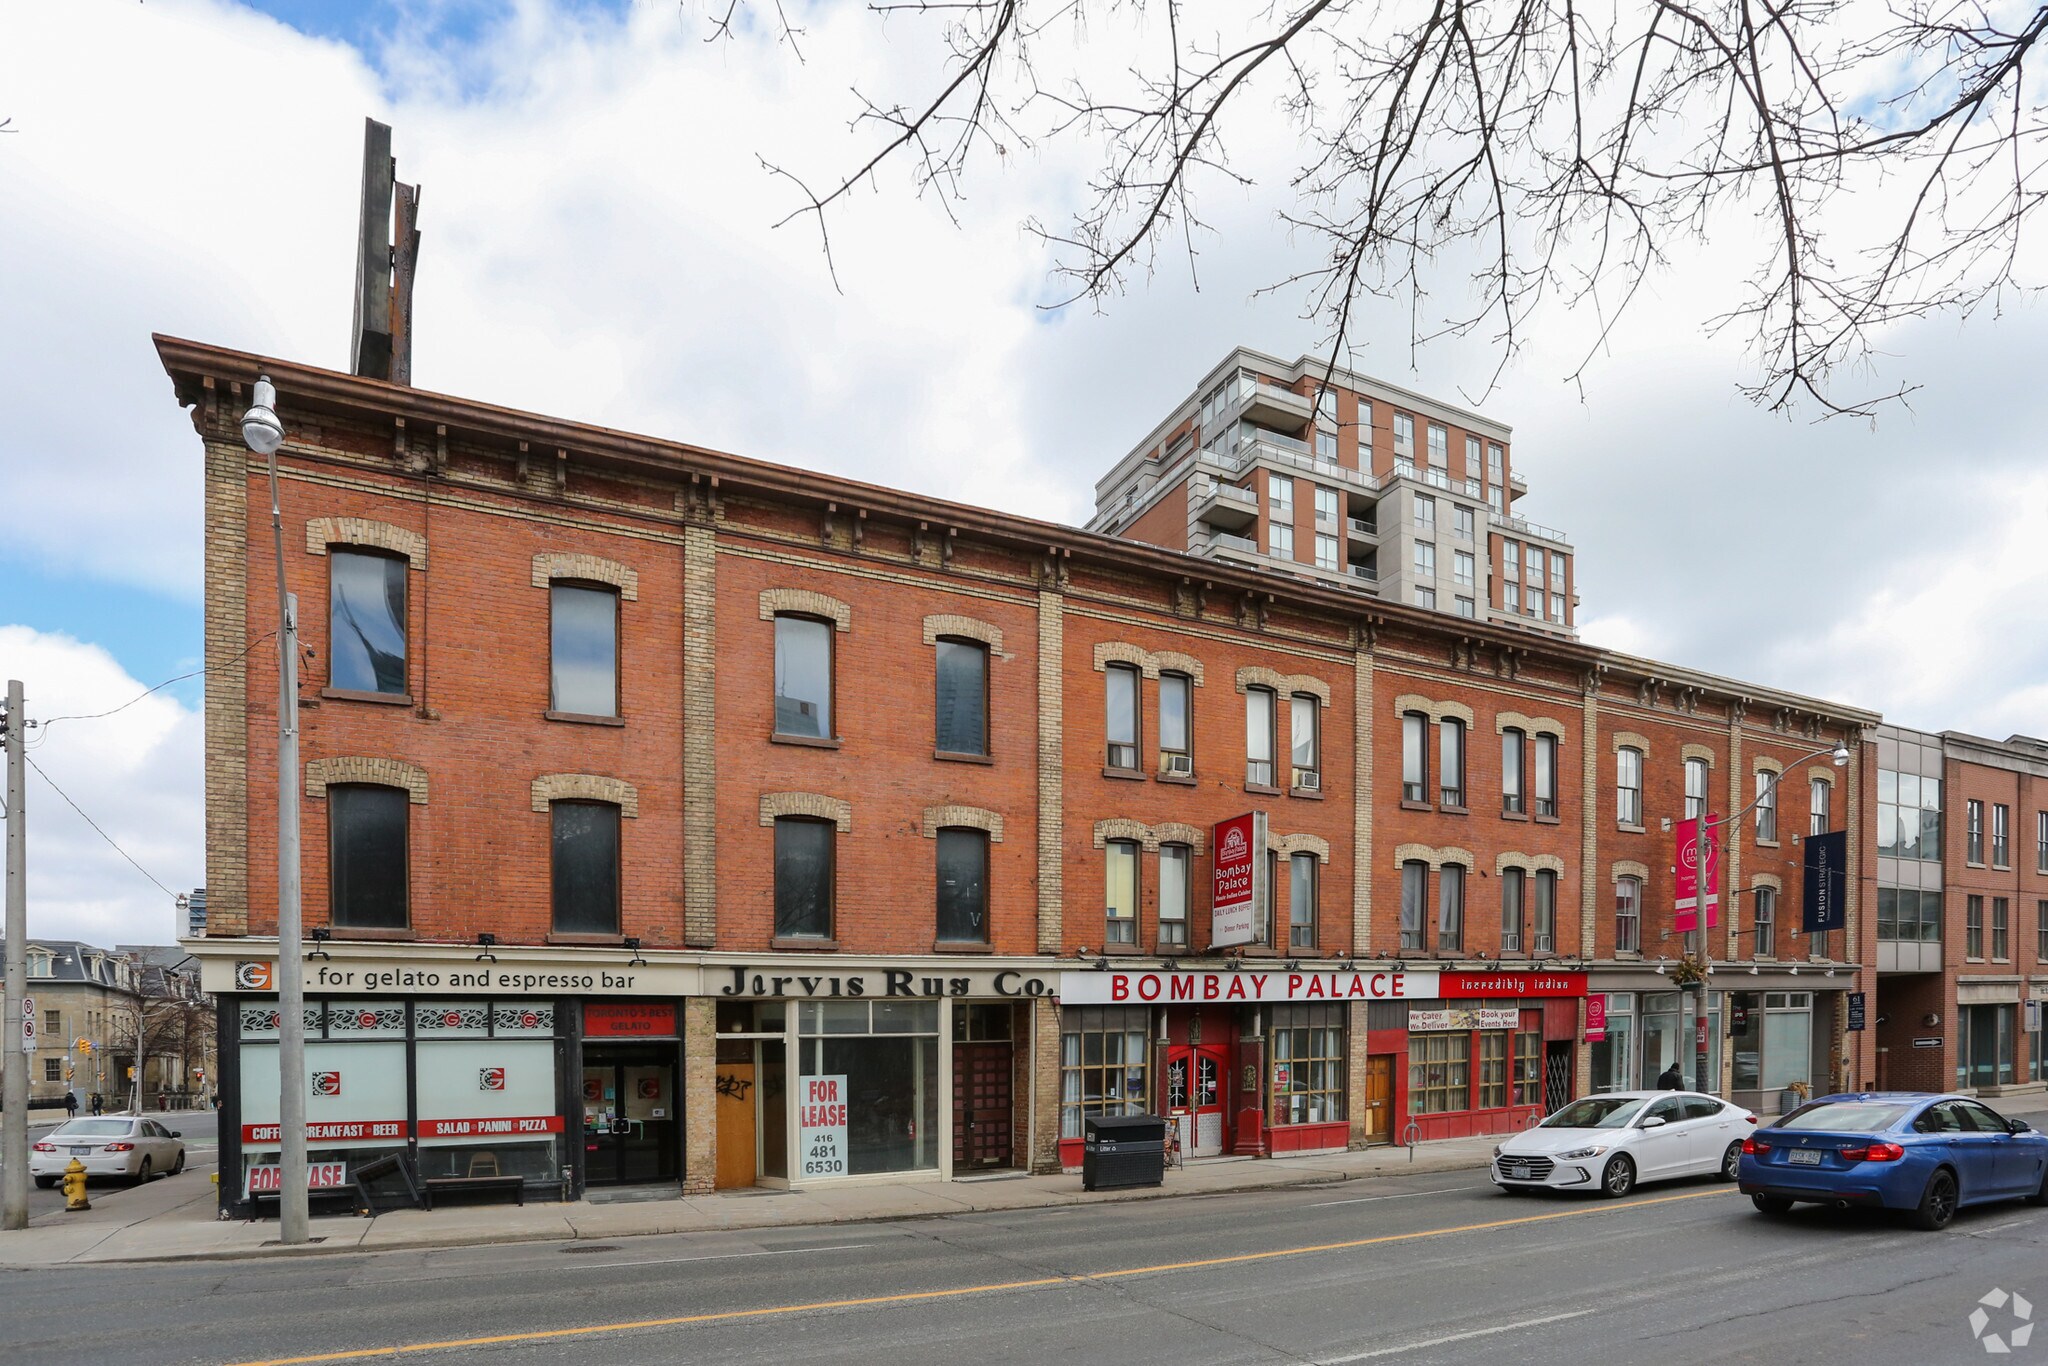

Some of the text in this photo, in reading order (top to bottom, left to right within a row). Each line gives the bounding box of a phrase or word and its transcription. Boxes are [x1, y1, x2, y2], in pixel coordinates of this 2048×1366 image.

[1215, 863, 1251, 880] Bombay
[1219, 877, 1248, 895] Palace
[1817, 846, 1826, 923] FUSION STRATEGIC
[1214, 902, 1252, 918] DAILY LUNCH BUFFET
[1235, 922, 1249, 931] Parking
[364, 968, 440, 990] gelato
[449, 970, 490, 987] and
[499, 974, 593, 991] espresso
[602, 971, 635, 988] bar
[722, 967, 1054, 997] Jarvis Rug Co.
[1461, 978, 1569, 993] incredibly indian
[1111, 973, 1405, 1001] BOMBAY PALACE
[588, 1008, 673, 1018] TORONTO'S BEST
[1421, 1012, 1443, 1020] Cater
[1480, 1010, 1516, 1020] Book your
[610, 1022, 651, 1030] GELATO
[1409, 1021, 1448, 1030] We Deliver
[1480, 1019, 1518, 1028] Events Here
[809, 1080, 838, 1102] FOR
[801, 1104, 846, 1128] LEASE
[372, 1123, 399, 1136] BEER
[436, 1119, 547, 1134] SALAD PANINI PIZZA
[814, 1134, 833, 1143] 416
[809, 1145, 836, 1158] 481
[805, 1160, 843, 1174] 6530
